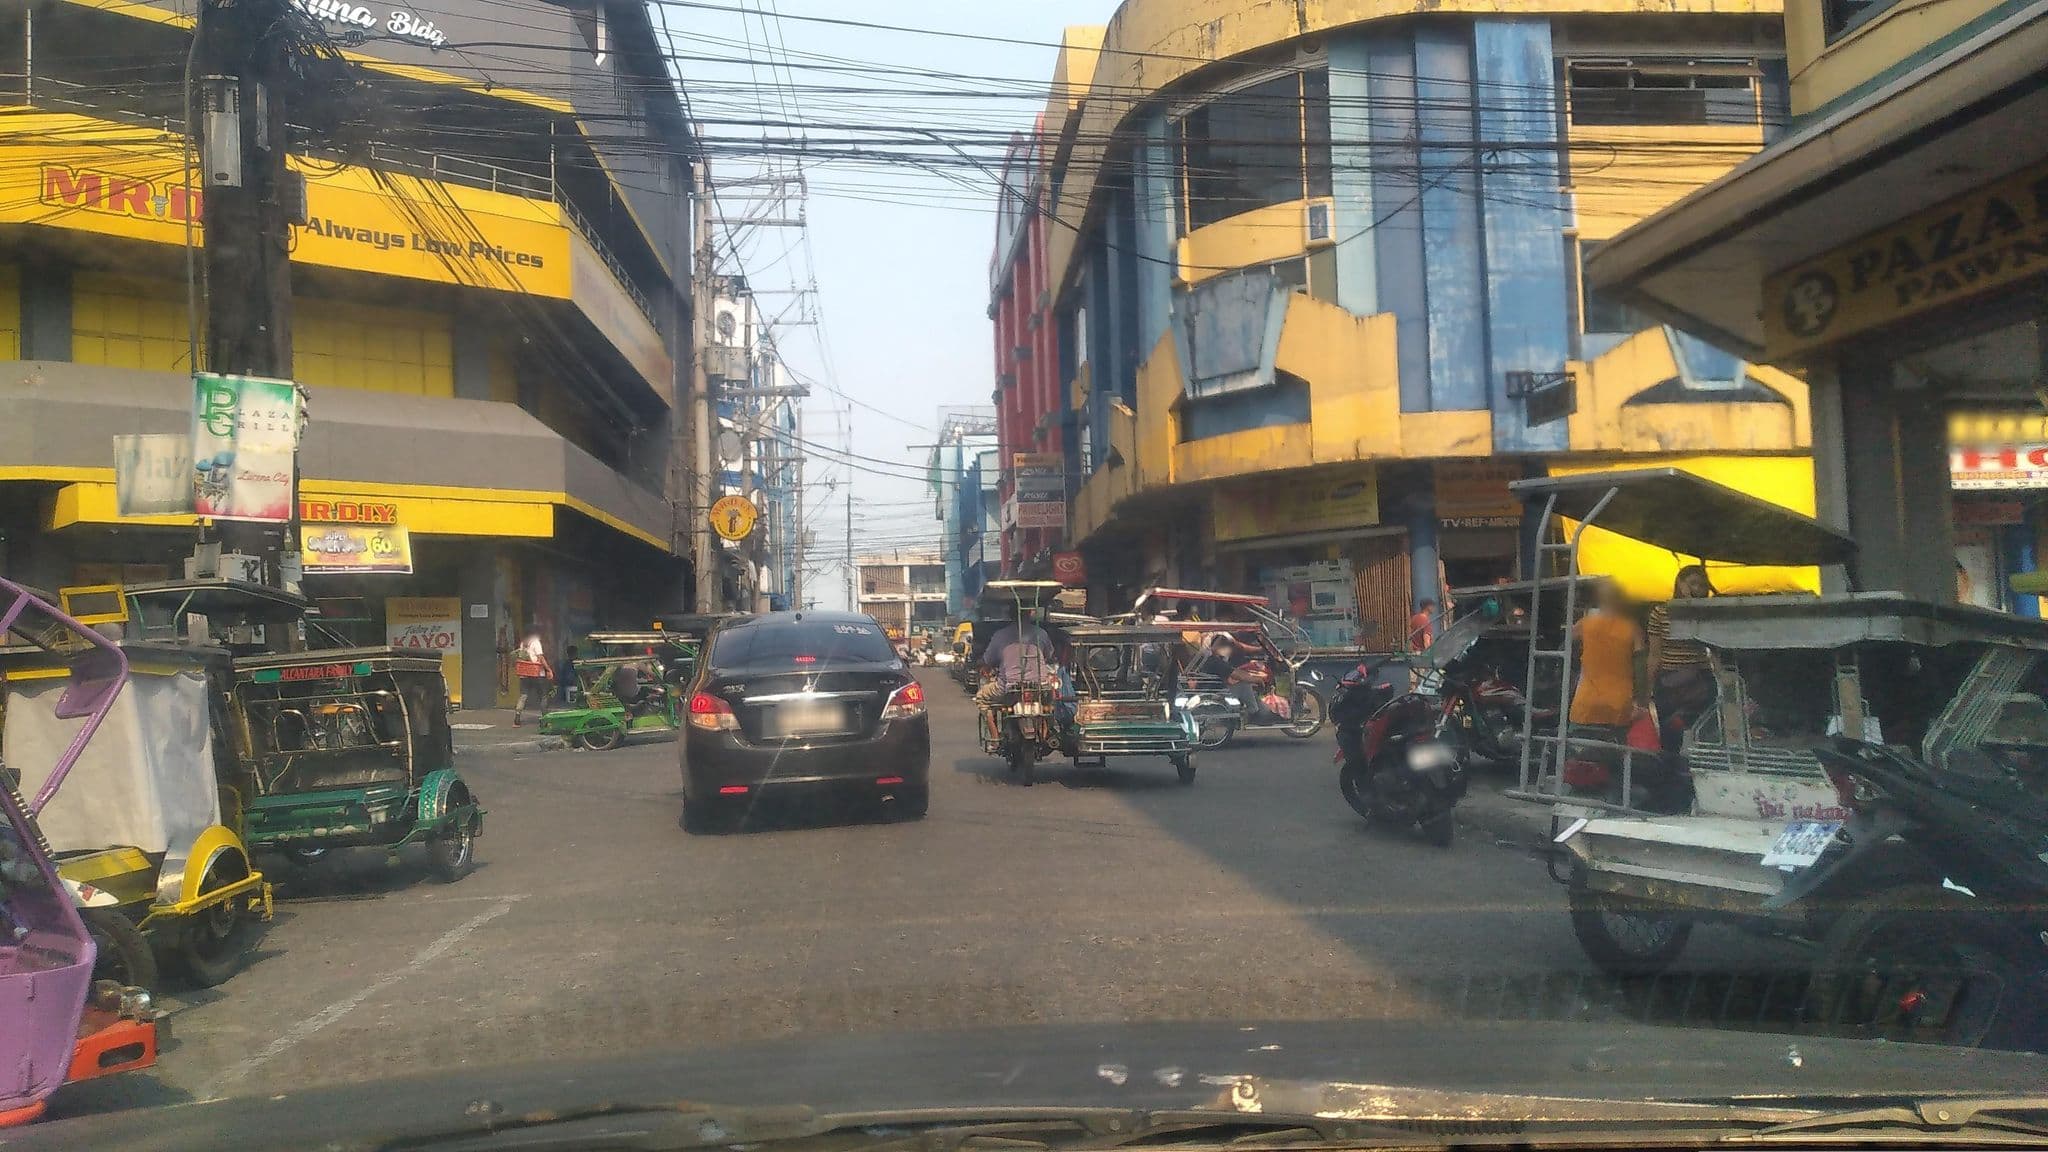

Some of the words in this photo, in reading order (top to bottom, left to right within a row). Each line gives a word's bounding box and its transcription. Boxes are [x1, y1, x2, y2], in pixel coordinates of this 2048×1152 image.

[386, 11, 447, 46] Bldg
[304, 216, 405, 250] Always
[411, 232, 462, 256] Low
[468, 240, 544, 268] Prices
[237, 470, 271, 483] Lucena
[273, 472, 290, 487] City
[393, 632, 456, 649] KAYO!
